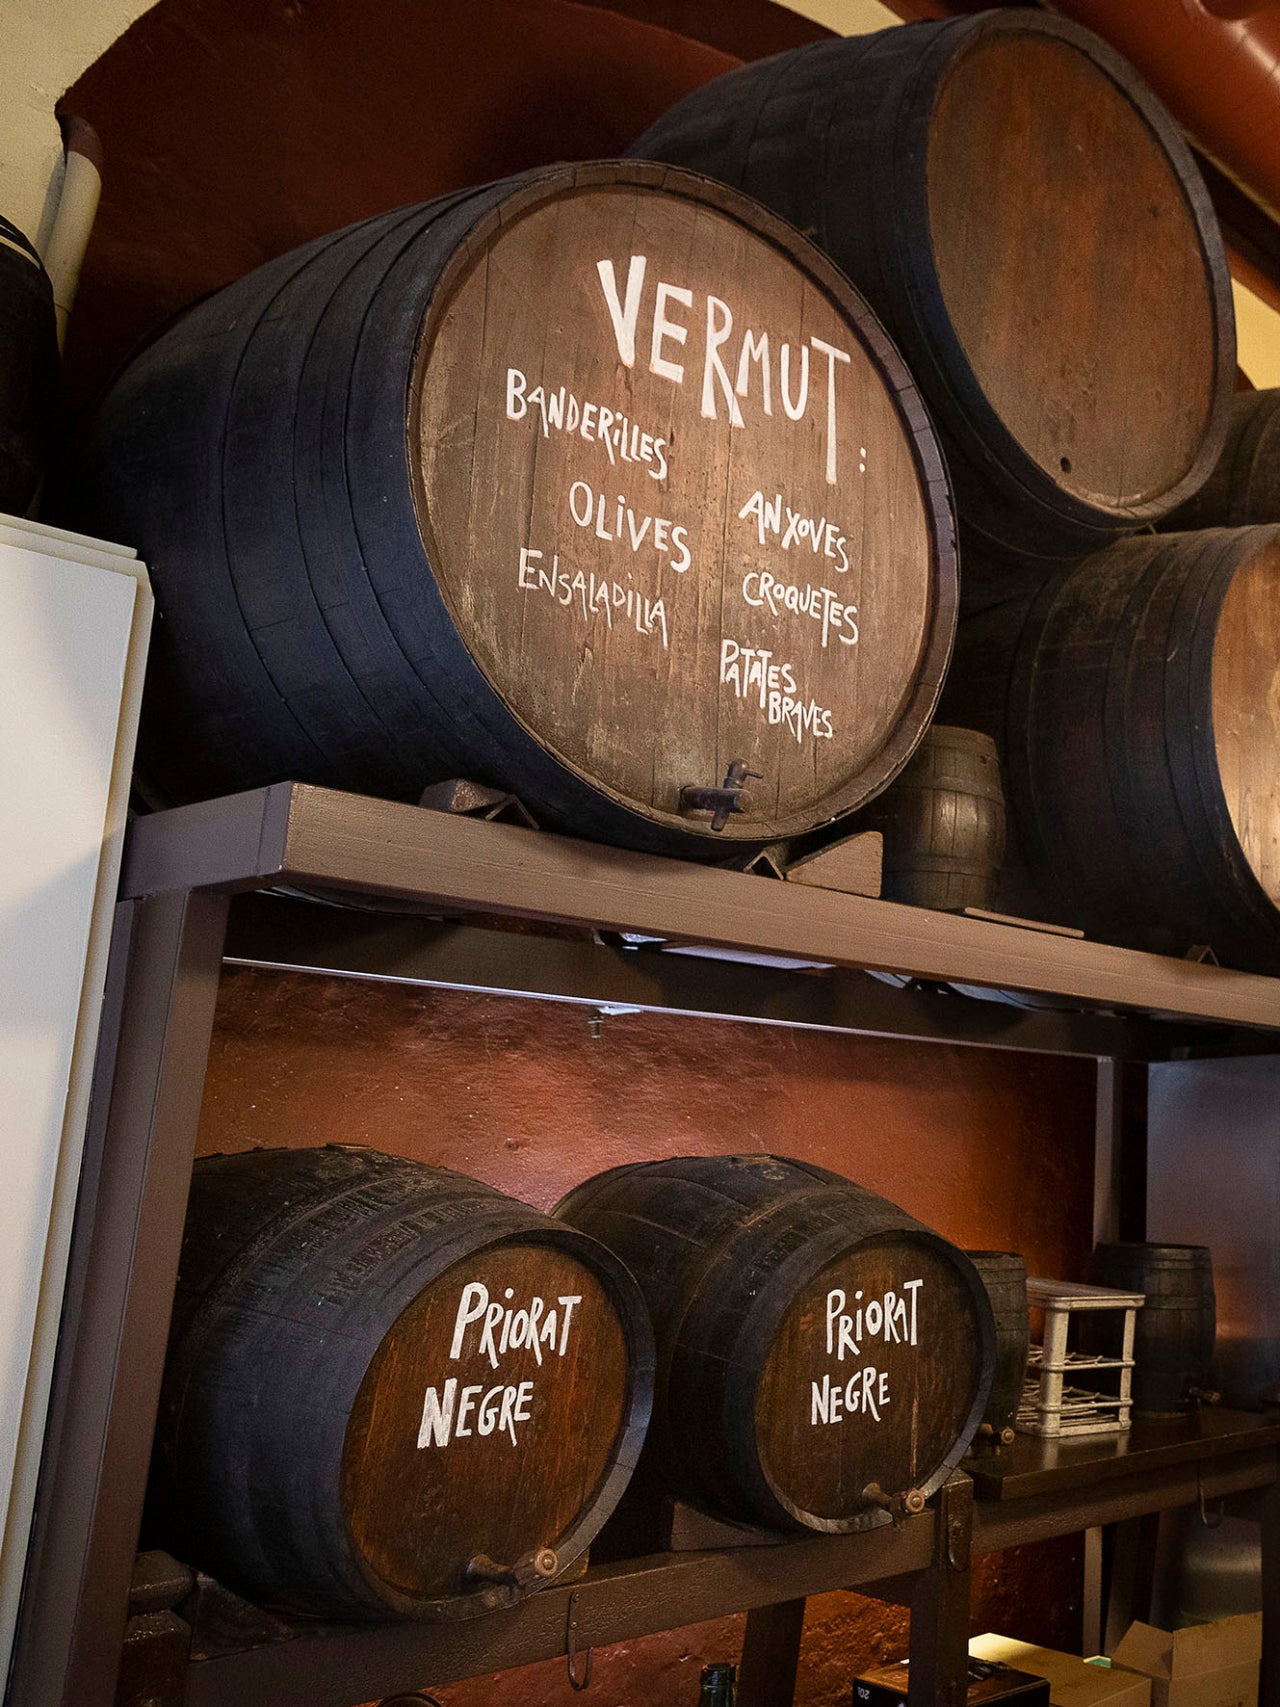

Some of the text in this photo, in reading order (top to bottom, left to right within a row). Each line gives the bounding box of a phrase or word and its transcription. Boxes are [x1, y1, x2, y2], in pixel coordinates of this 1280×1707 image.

[506, 368, 668, 481] BANDERILLES
[569, 481, 691, 573] OLIVES
[738, 491, 849, 573] ANXOVES
[518, 548, 668, 648] ENSALADILLA
[742, 572, 859, 648] CROQUETES
[720, 639, 797, 708] PATATES
[768, 691, 833, 744] BRAVES
[450, 1282, 582, 1369] PRIORAT
[827, 1279, 923, 1360] PRIORAT
[417, 1378, 534, 1448] NEGRE
[811, 1367, 890, 1425] NEGRE
